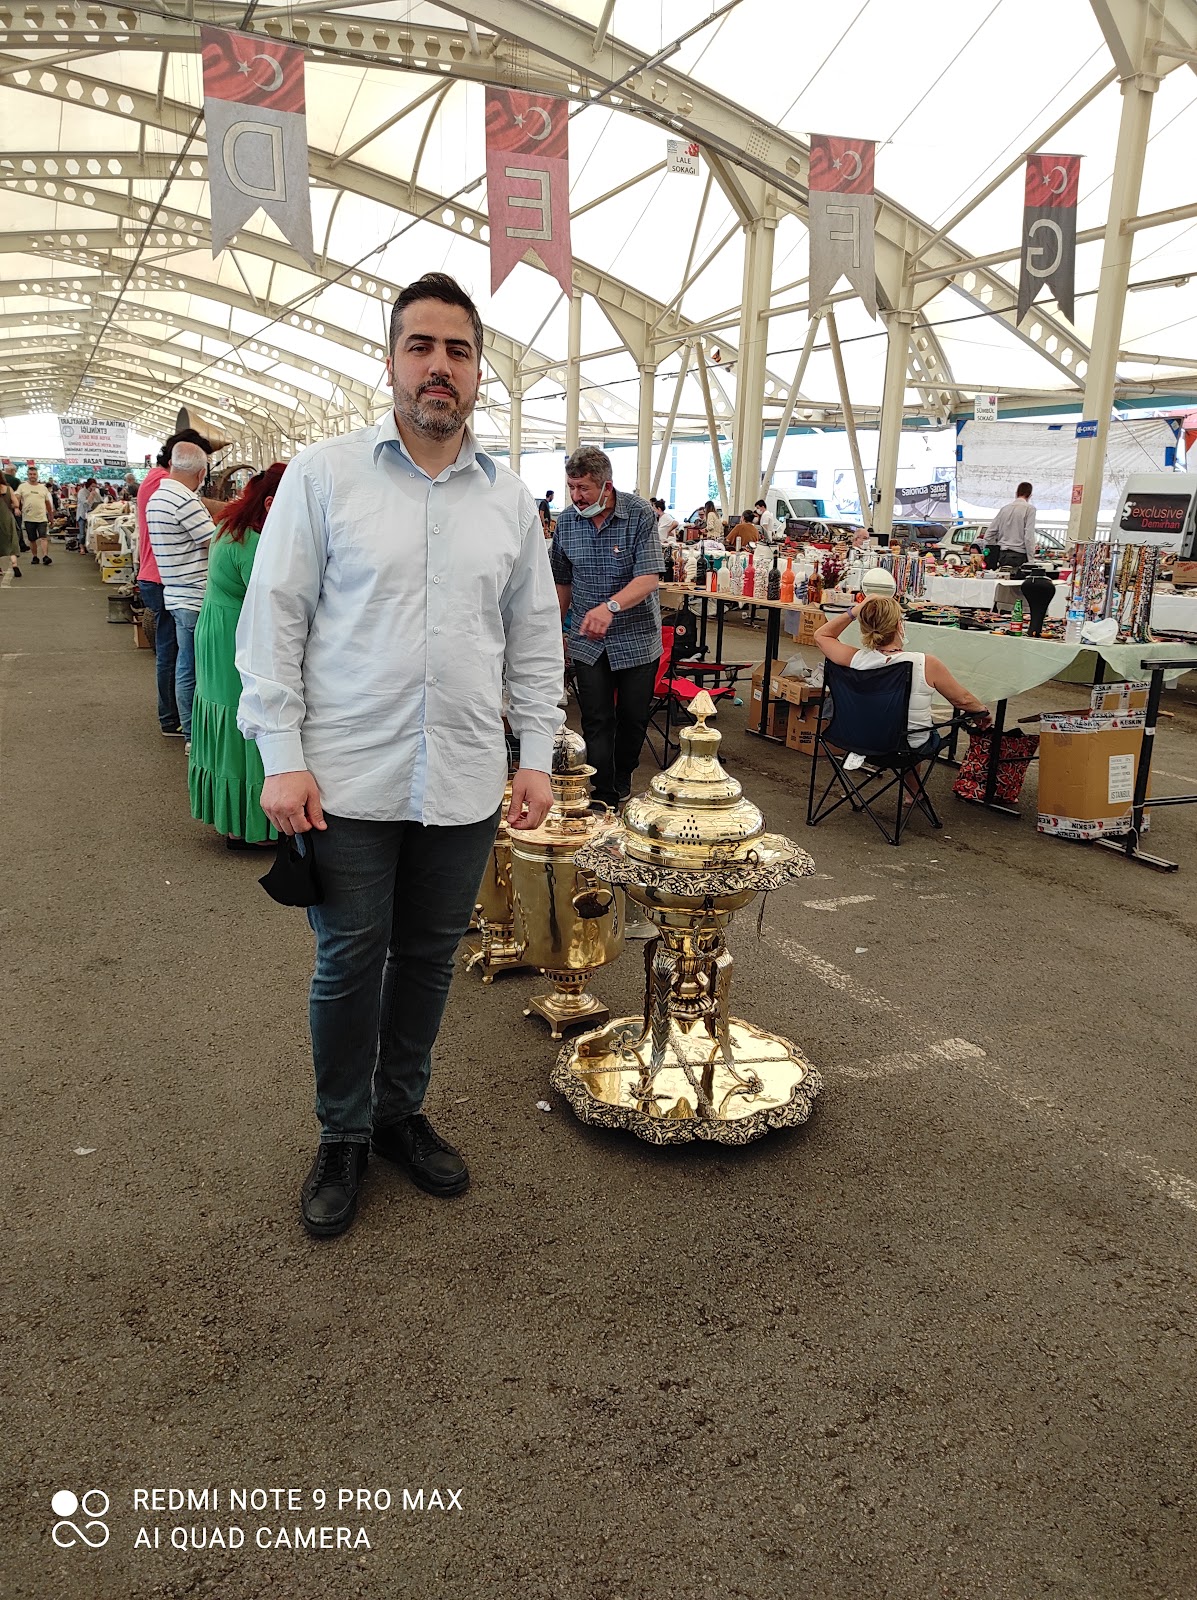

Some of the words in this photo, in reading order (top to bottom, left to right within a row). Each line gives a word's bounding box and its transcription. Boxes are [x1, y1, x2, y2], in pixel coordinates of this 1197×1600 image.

[676, 156, 692, 165] LALE
[671, 165, 696, 175] SOKAĞI
[901, 486, 929, 496] Salonda
[930, 484, 947, 493] Sanat
[1132, 506, 1184, 519] exclusive
[1141, 518, 1180, 529] Demirhan
[1071, 822, 1096, 830] KESKIN
